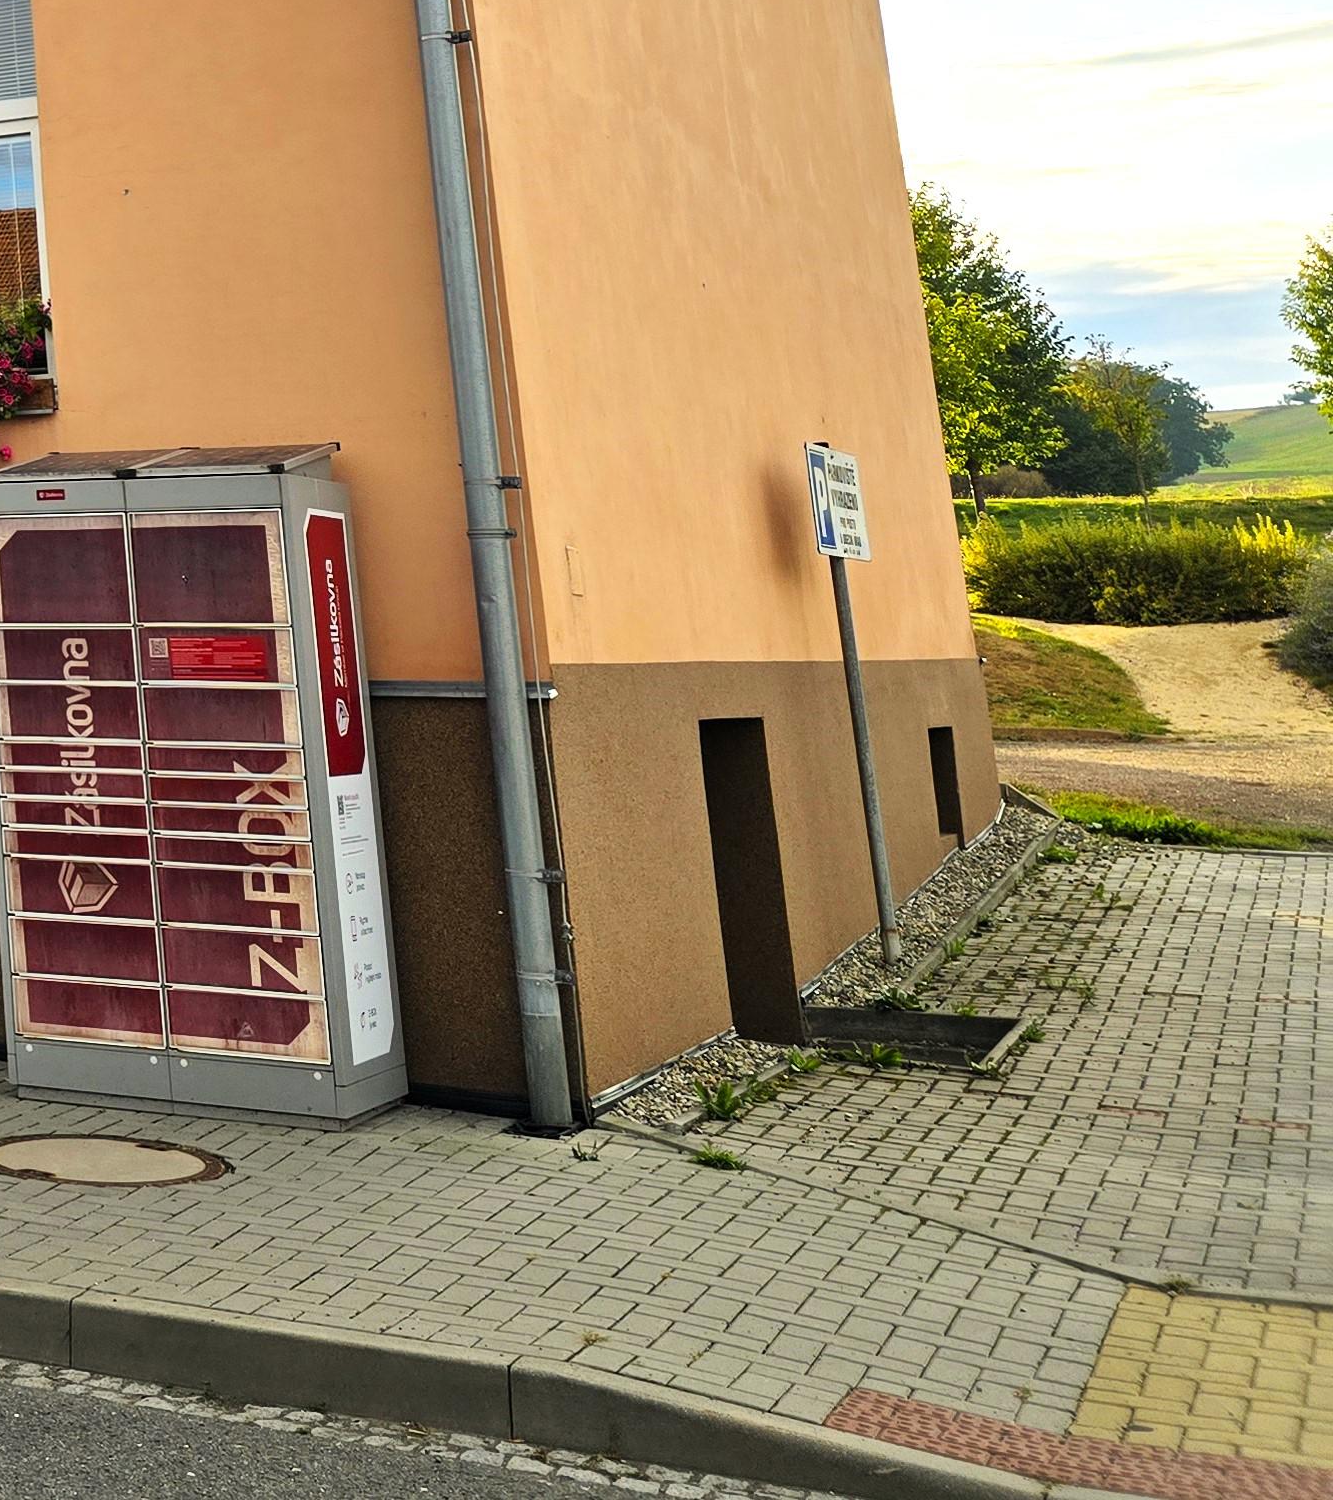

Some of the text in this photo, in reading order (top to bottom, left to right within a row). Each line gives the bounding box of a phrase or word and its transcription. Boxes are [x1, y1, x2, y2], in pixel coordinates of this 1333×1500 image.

[325, 559, 345, 689] Zásilkovna
[60, 636, 101, 836] Zásilkovna
[233, 760, 307, 994] Z-BOX
